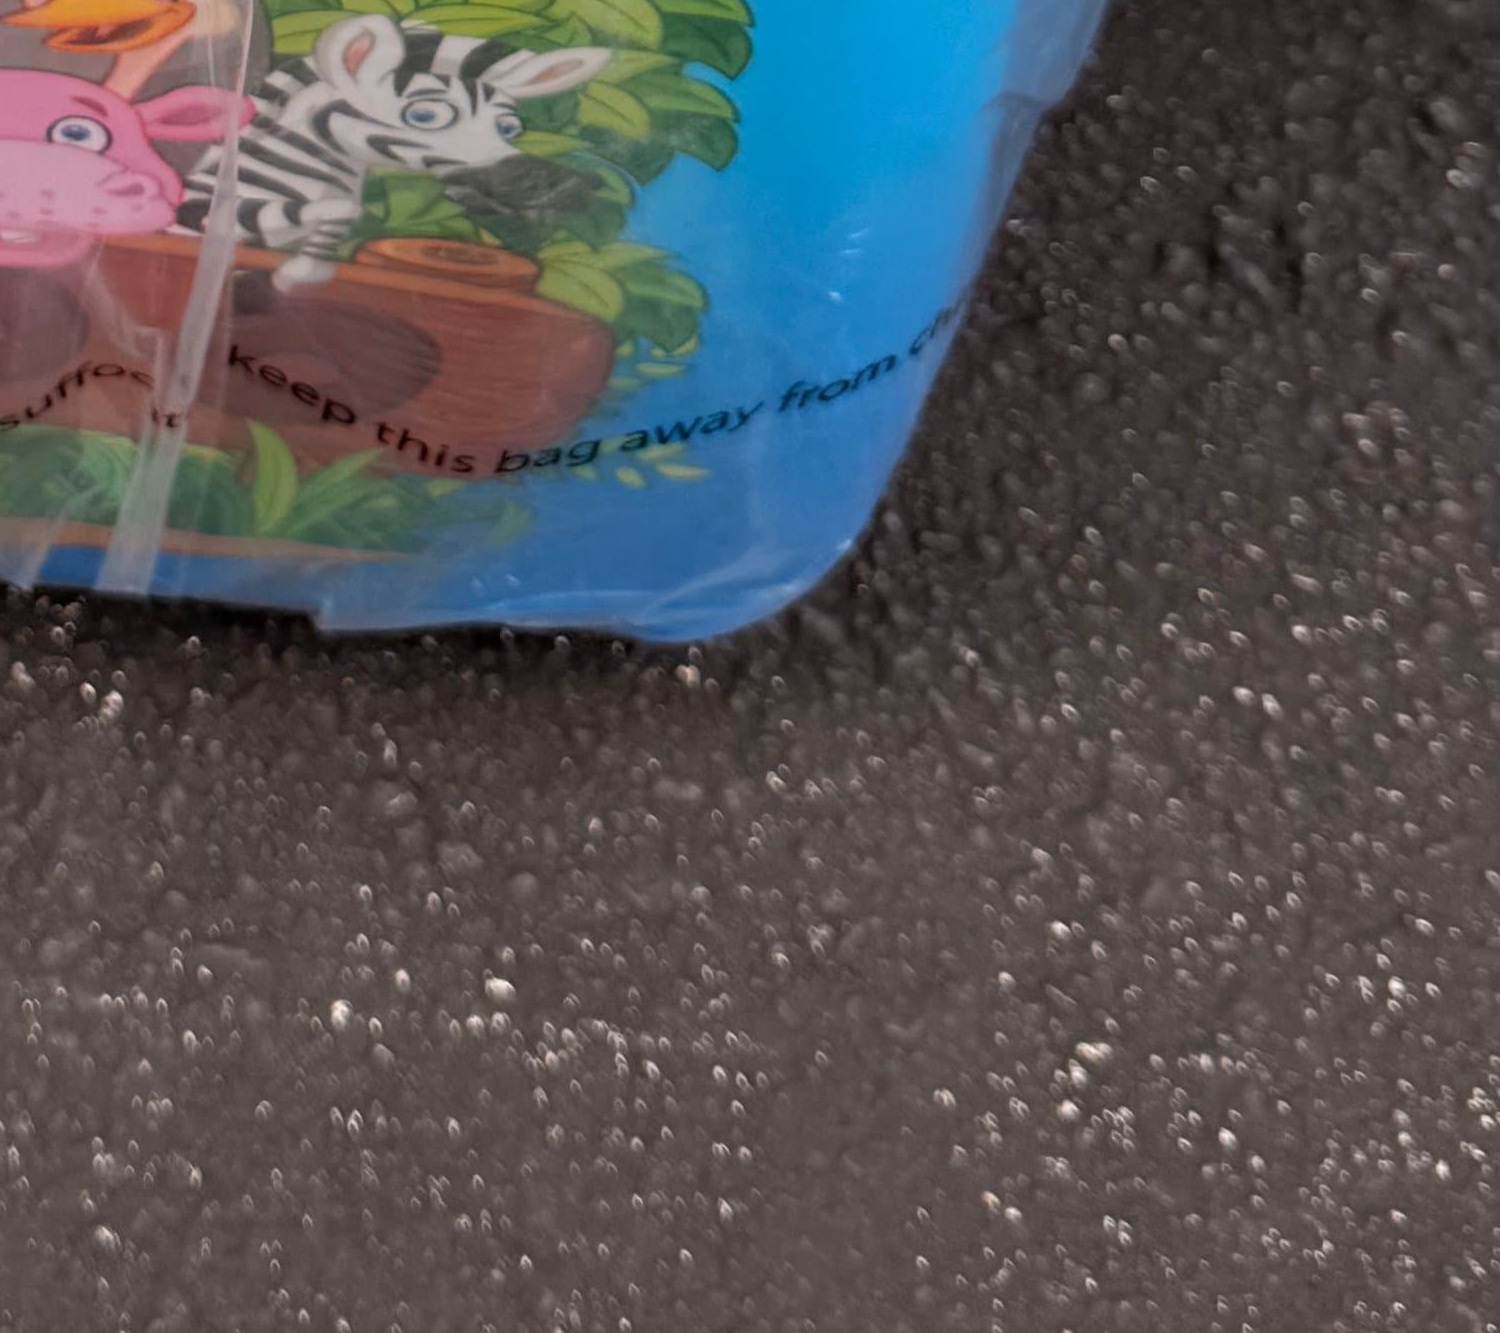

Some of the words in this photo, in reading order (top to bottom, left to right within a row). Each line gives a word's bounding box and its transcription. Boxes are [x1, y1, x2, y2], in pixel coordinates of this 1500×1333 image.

[228, 344, 357, 428] keep
[375, 422, 475, 475] this
[495, 436, 600, 476] bag
[619, 399, 767, 454] away
[778, 353, 898, 413] from
